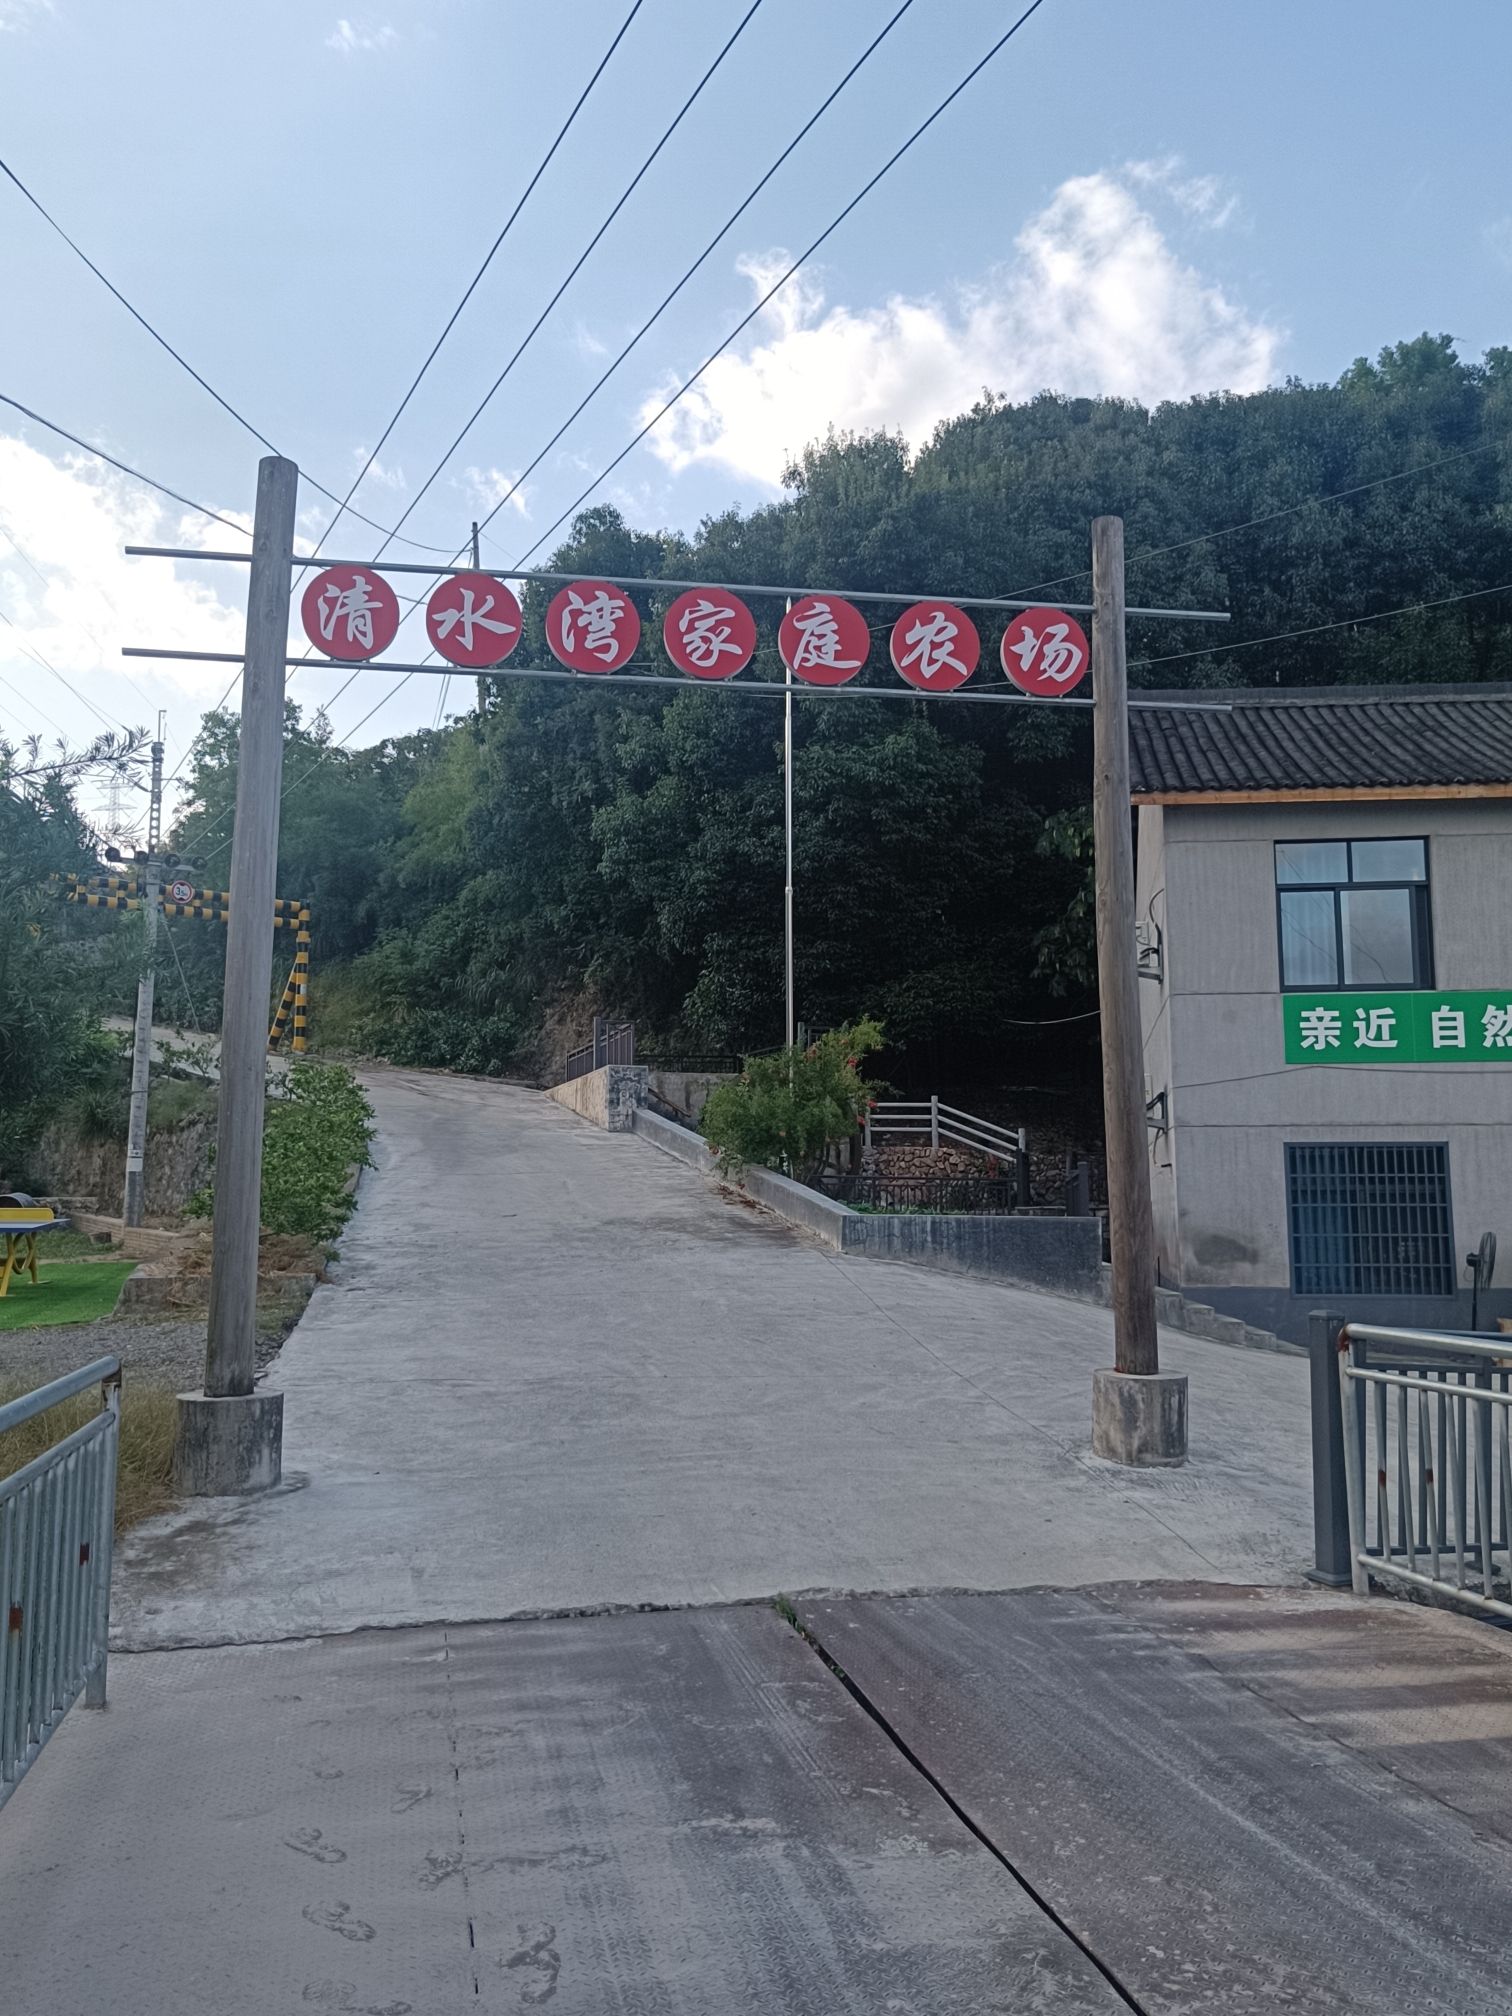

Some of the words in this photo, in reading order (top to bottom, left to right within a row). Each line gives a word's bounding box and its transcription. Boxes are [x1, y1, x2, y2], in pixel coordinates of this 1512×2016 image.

[316, 576, 1082, 682] 清水湾家庭农场
